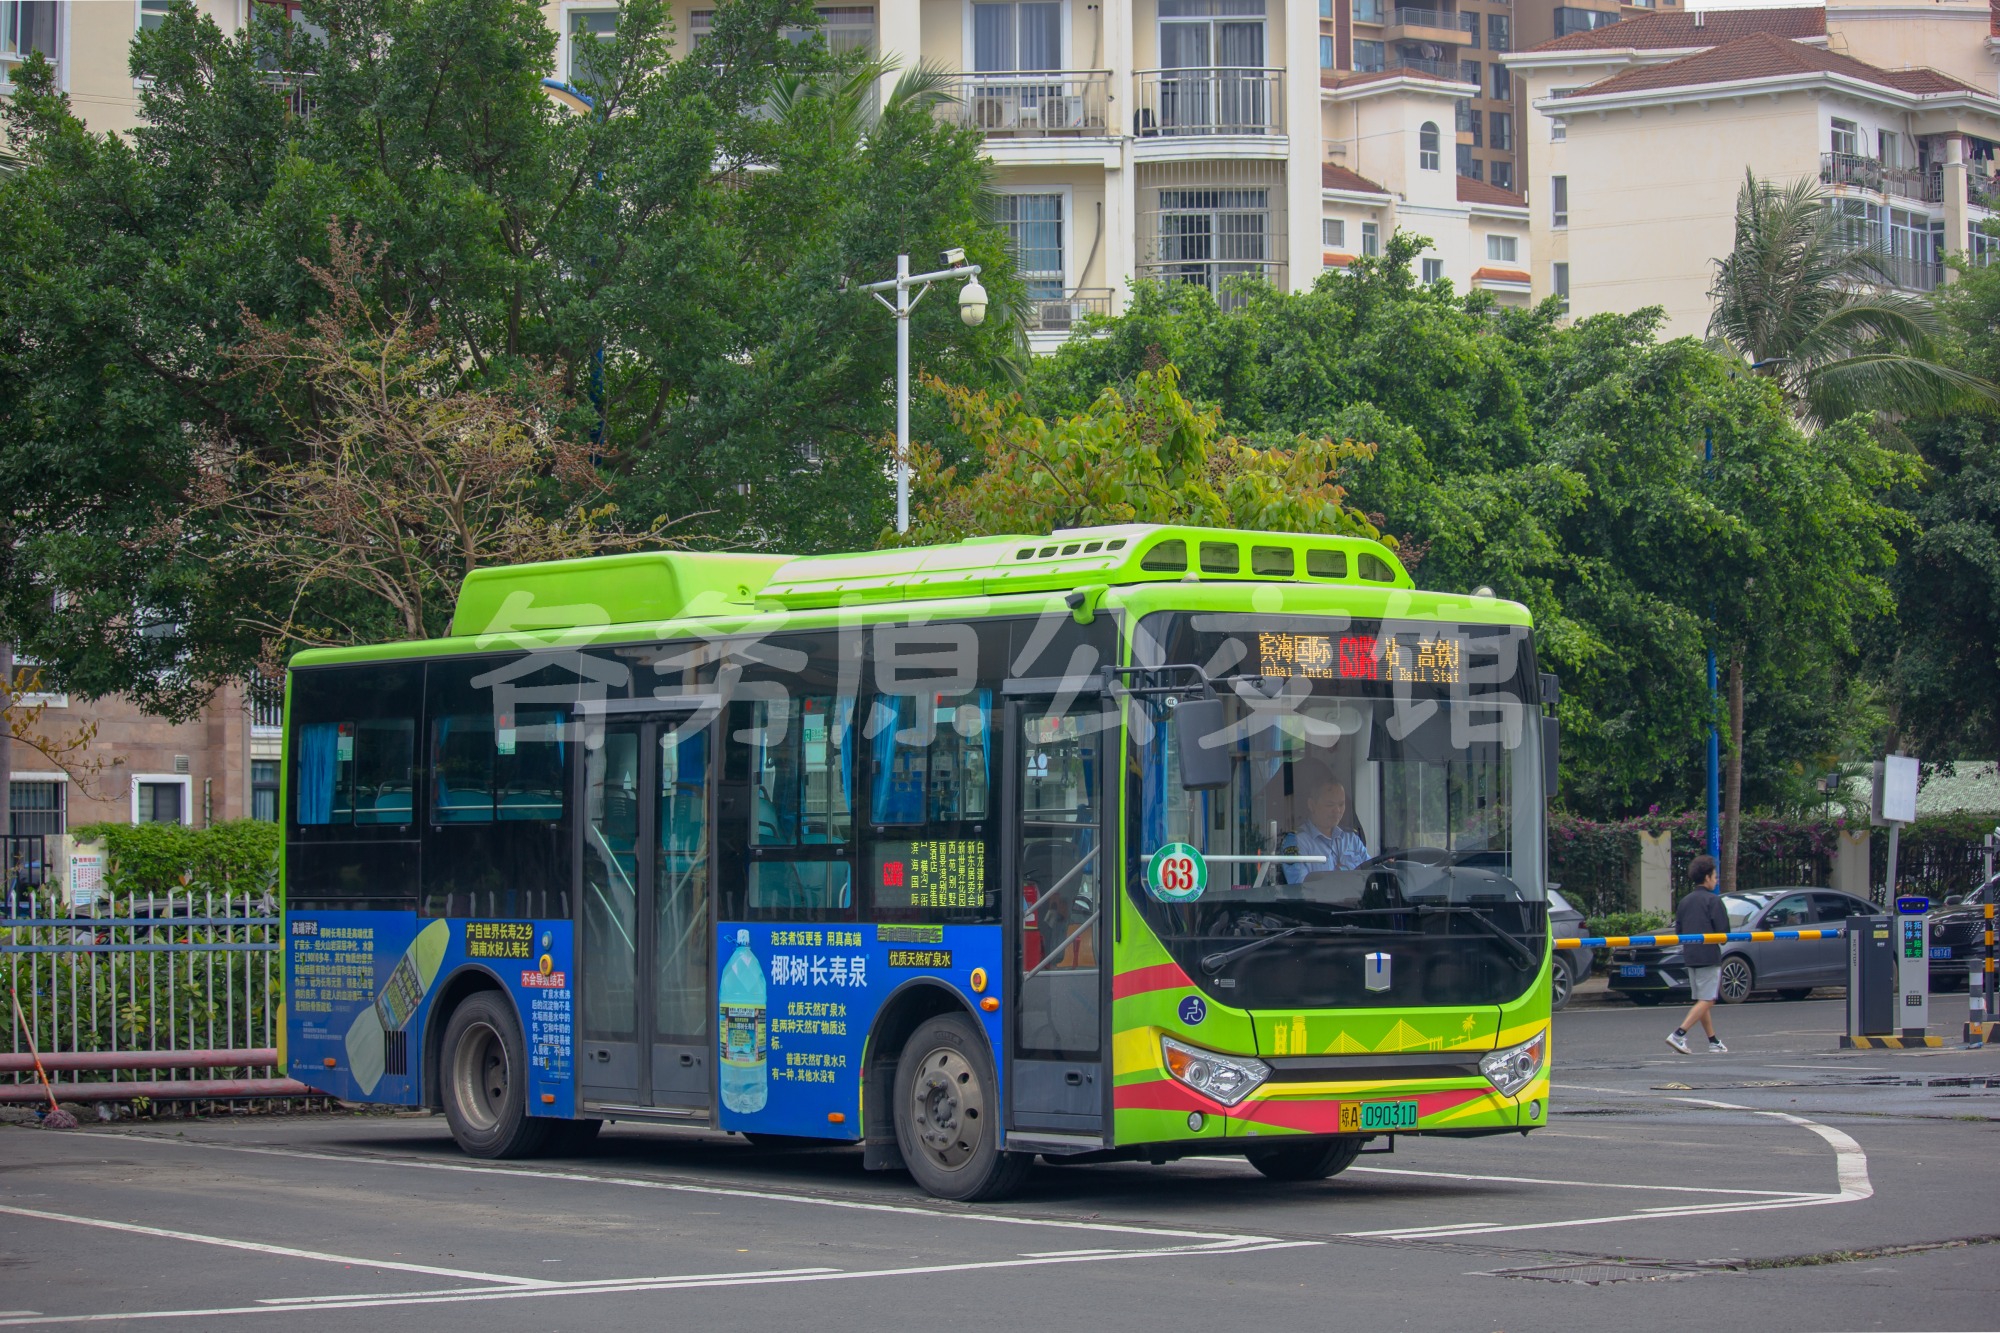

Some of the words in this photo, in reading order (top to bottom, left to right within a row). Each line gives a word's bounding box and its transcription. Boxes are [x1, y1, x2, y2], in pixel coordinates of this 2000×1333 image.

[1417, 639, 1459, 669] 高铁
[1161, 857, 1193, 890] 63
[466, 923, 533, 940] 产自世界长寿之乡
[1904, 921, 1922, 930] 科拓
[771, 931, 822, 946] 泡茶煮饭更香
[827, 931, 862, 947] 用真高端
[1904, 930, 1922, 939] 停车
[470, 941, 529, 957] 海南水好人寿长
[1905, 940, 1922, 948] 一路
[889, 951, 952, 968] 优质天然矿泉水
[1905, 949, 1922, 958] 平安
[771, 955, 868, 987] 椰树长寿泉
[522, 972, 565, 987] 不会导致结石
[788, 1001, 847, 1017] 优质天然矿泉水
[771, 1018, 847, 1036] 是两种天然矿物质达
[786, 1052, 847, 1067] 普通天然矿泉水只
